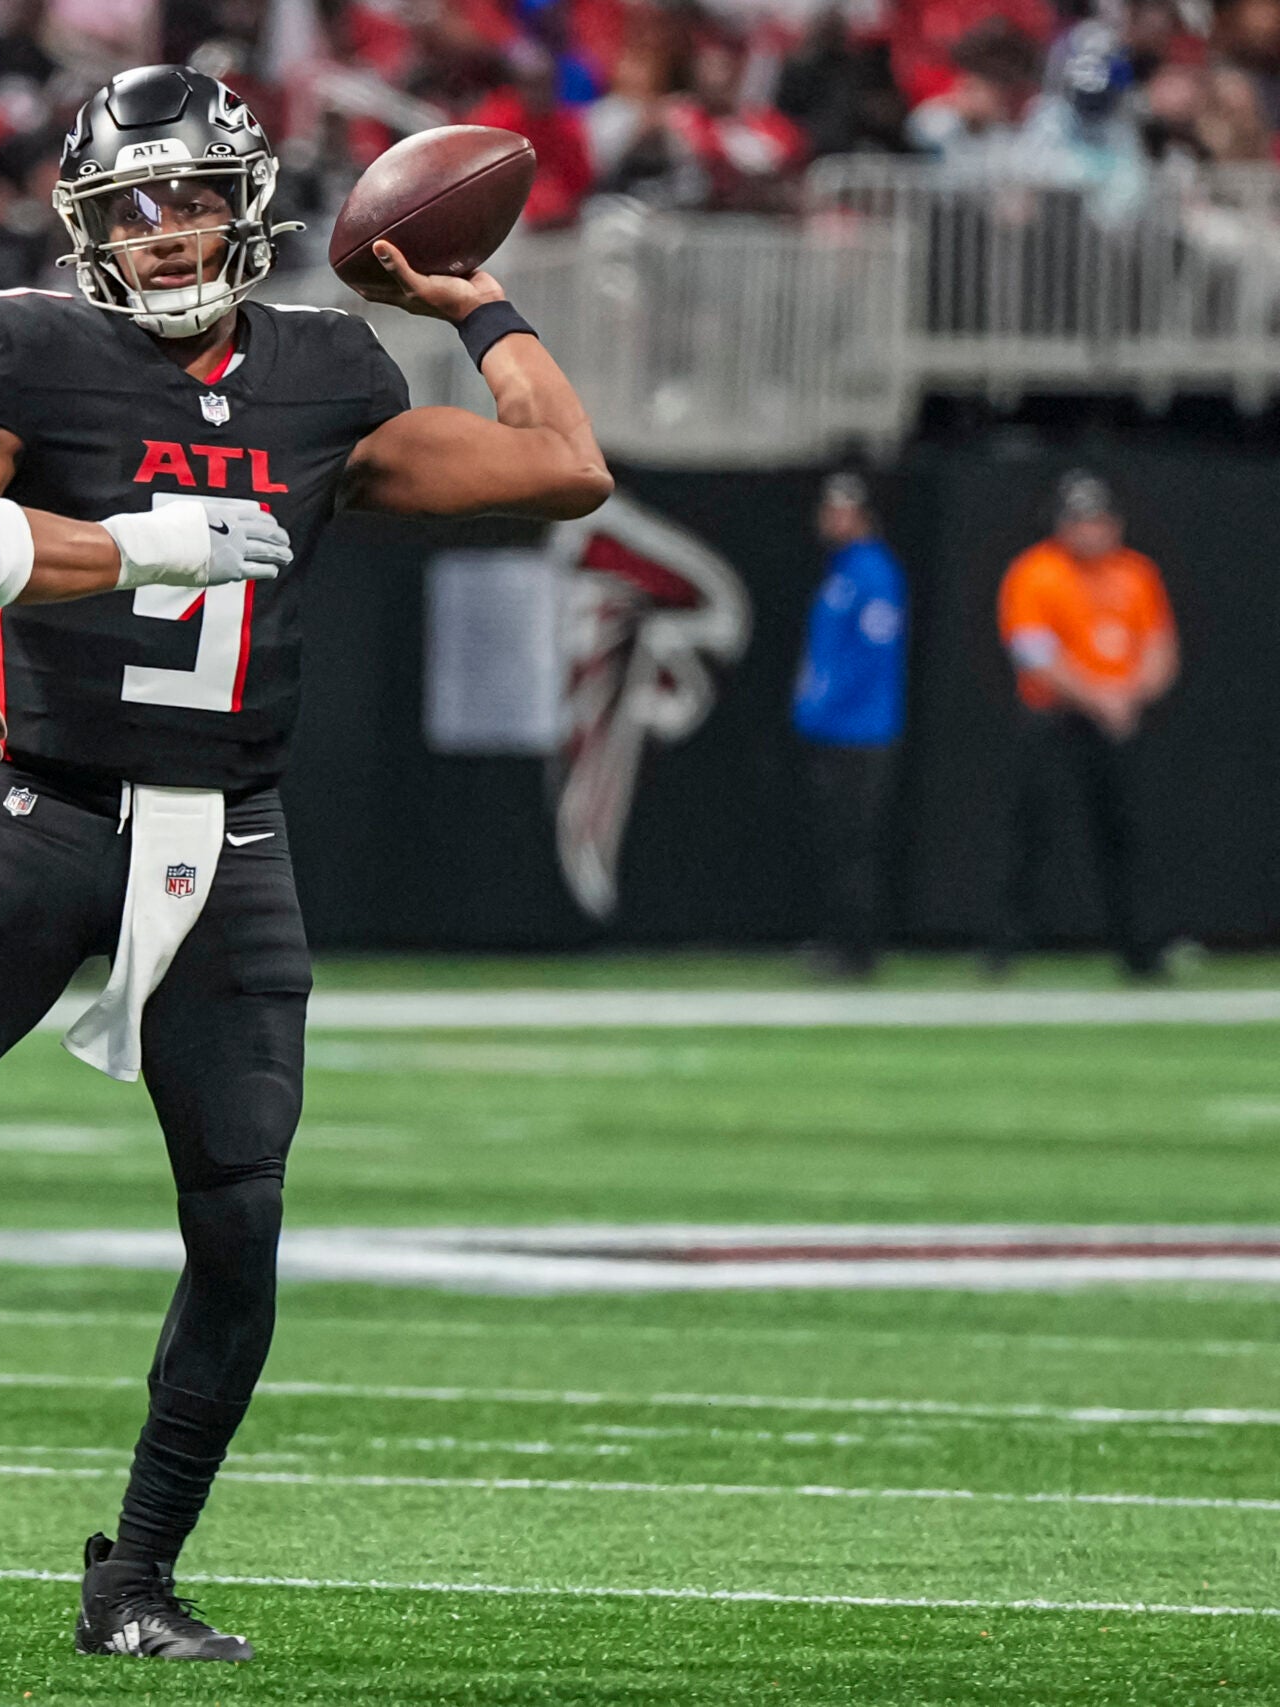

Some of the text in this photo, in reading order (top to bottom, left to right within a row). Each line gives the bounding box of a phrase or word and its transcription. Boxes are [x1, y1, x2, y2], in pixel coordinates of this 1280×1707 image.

[133, 143, 169, 159] ATL
[133, 440, 289, 493] ATL
[168, 878, 193, 895] NFL
